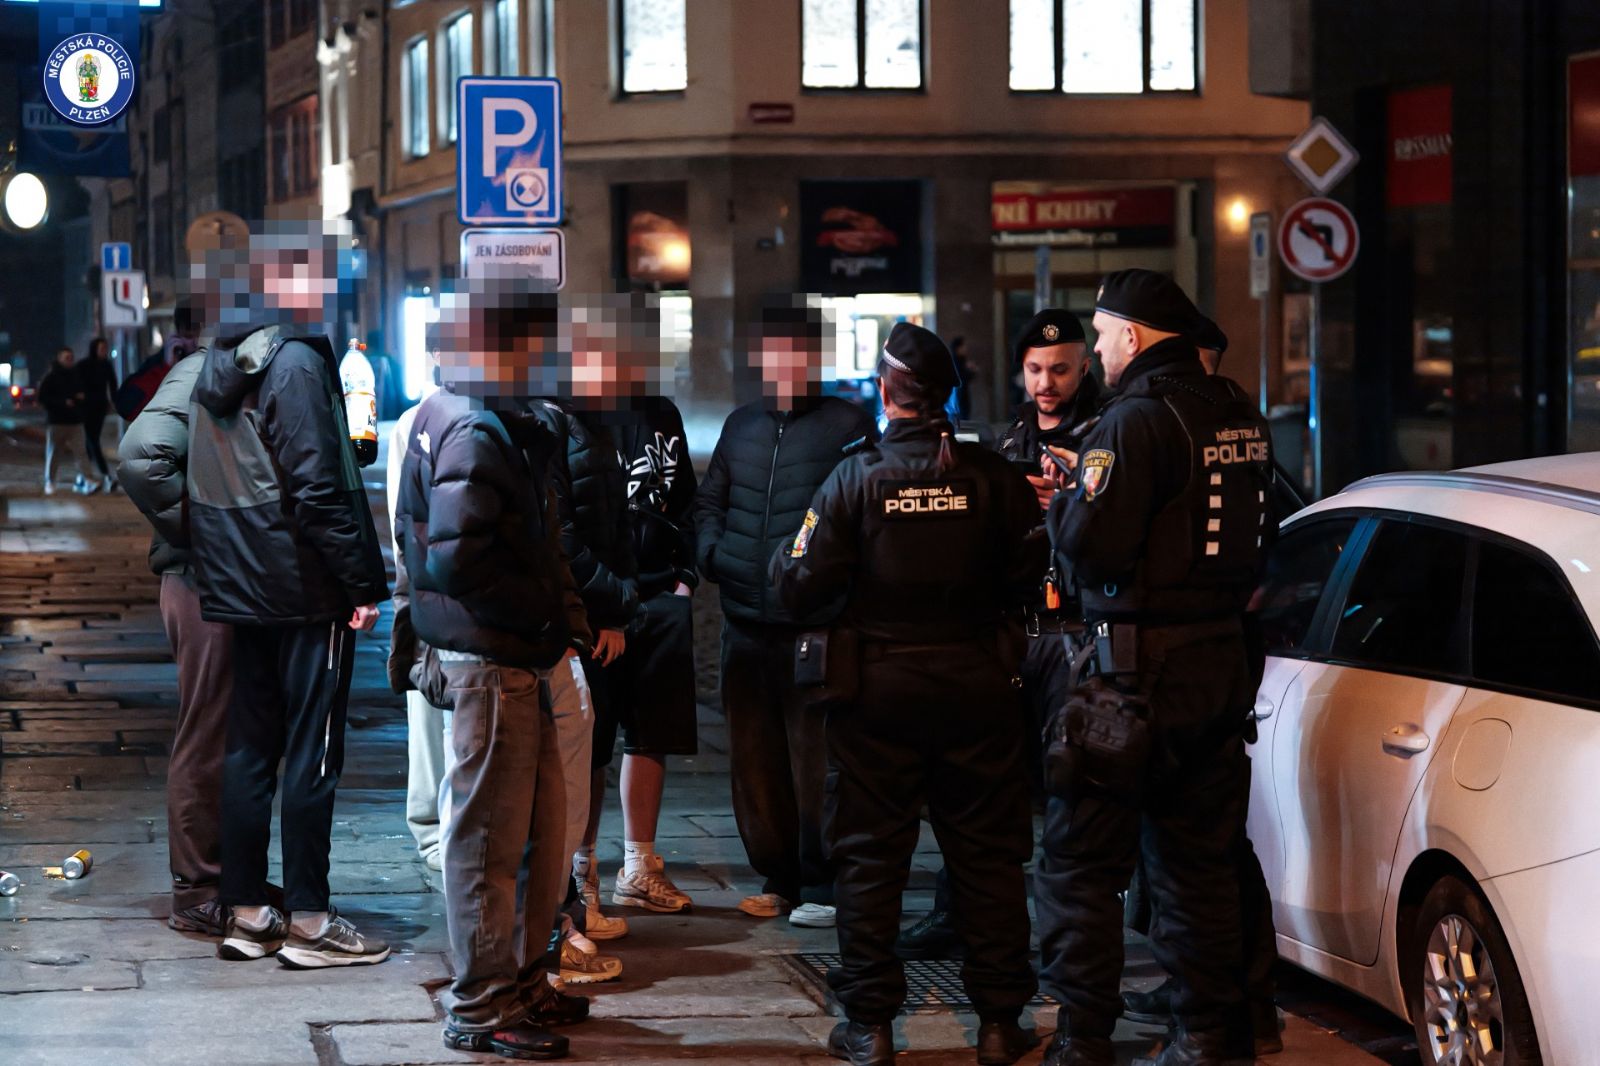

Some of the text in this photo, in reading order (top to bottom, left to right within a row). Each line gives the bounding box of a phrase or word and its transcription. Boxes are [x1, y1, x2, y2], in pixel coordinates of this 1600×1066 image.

[482, 97, 538, 176] P
[475, 241, 552, 257] JEN ZÁSOBOVÁNÍ
[1216, 426, 1261, 442] MĚSTSKÁ
[1203, 441, 1268, 467] POLICIE
[898, 485, 953, 498] MĚSTSKÁ
[885, 496, 968, 513] POLICIE
